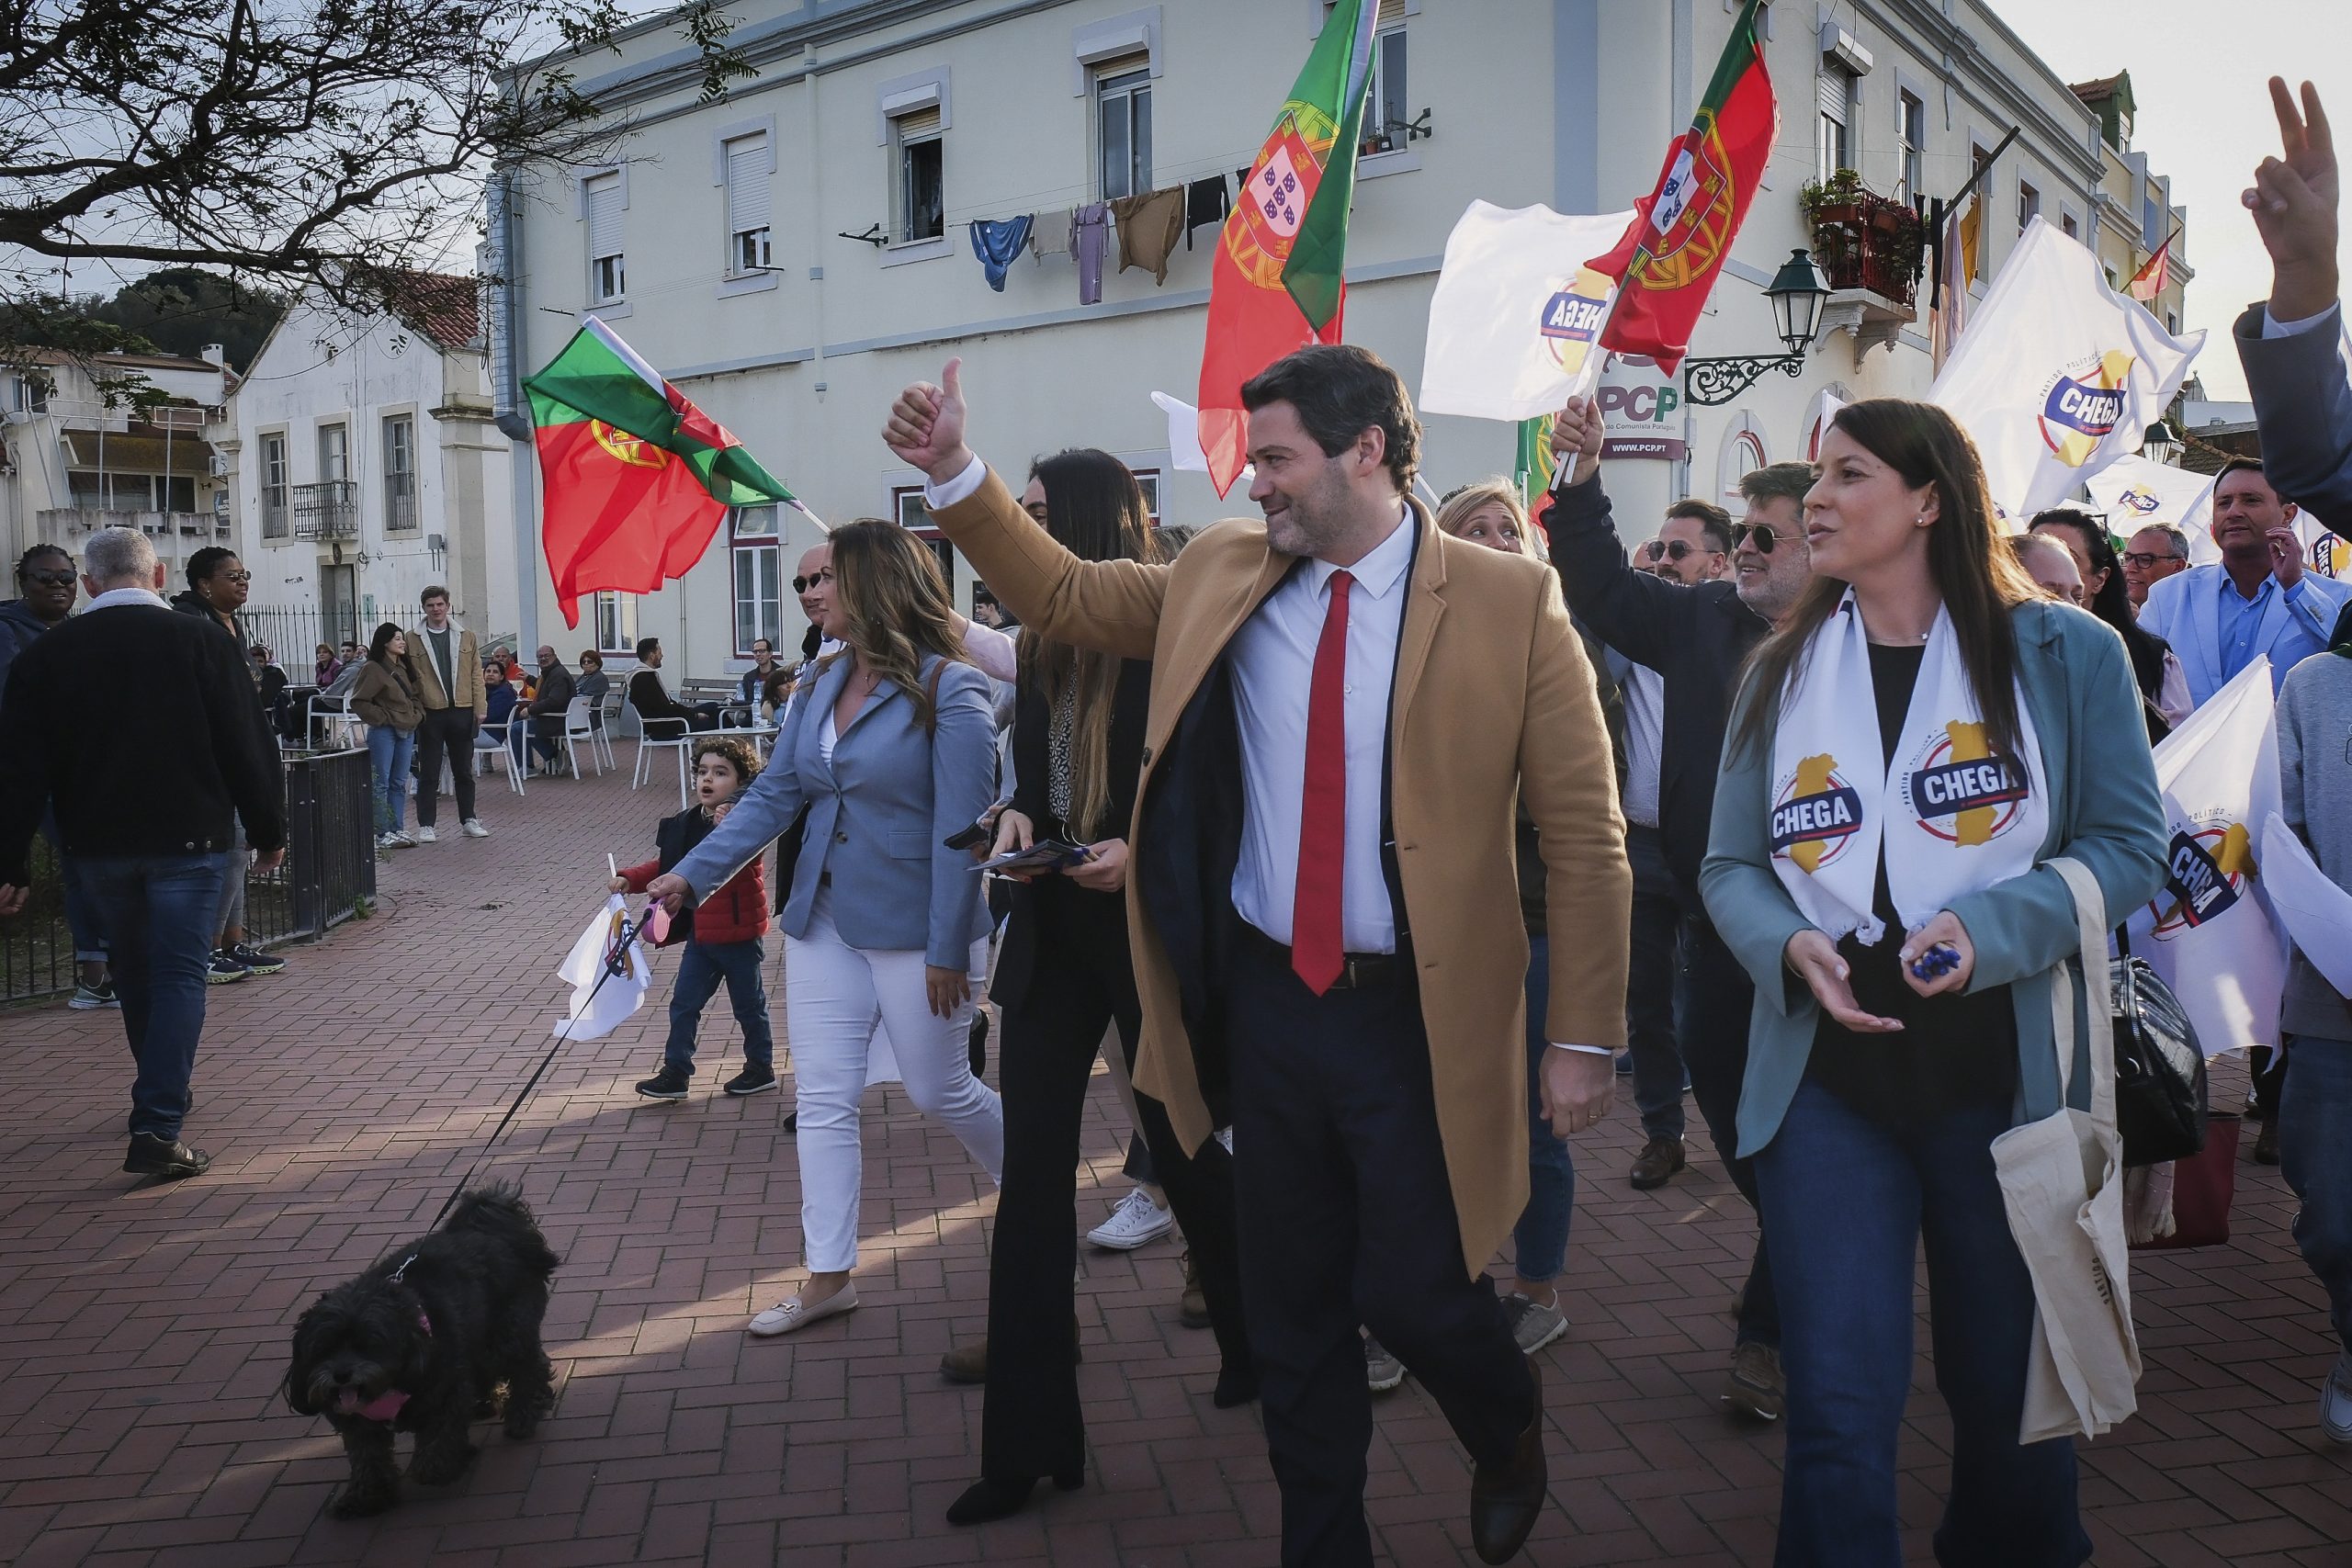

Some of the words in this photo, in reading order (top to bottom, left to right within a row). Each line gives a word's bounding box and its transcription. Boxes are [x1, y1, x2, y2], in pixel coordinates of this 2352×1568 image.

[1597, 385, 1679, 423] PCP
[2059, 387, 2119, 425] CHEGA
[1611, 444, 1667, 453] WWW.PCP.PT
[2316, 539, 2330, 577] CHEG
[1924, 762, 2019, 805] CHEGA
[1772, 795, 1853, 839] CHEGA
[2092, 1257, 2111, 1305] PARTIDO
